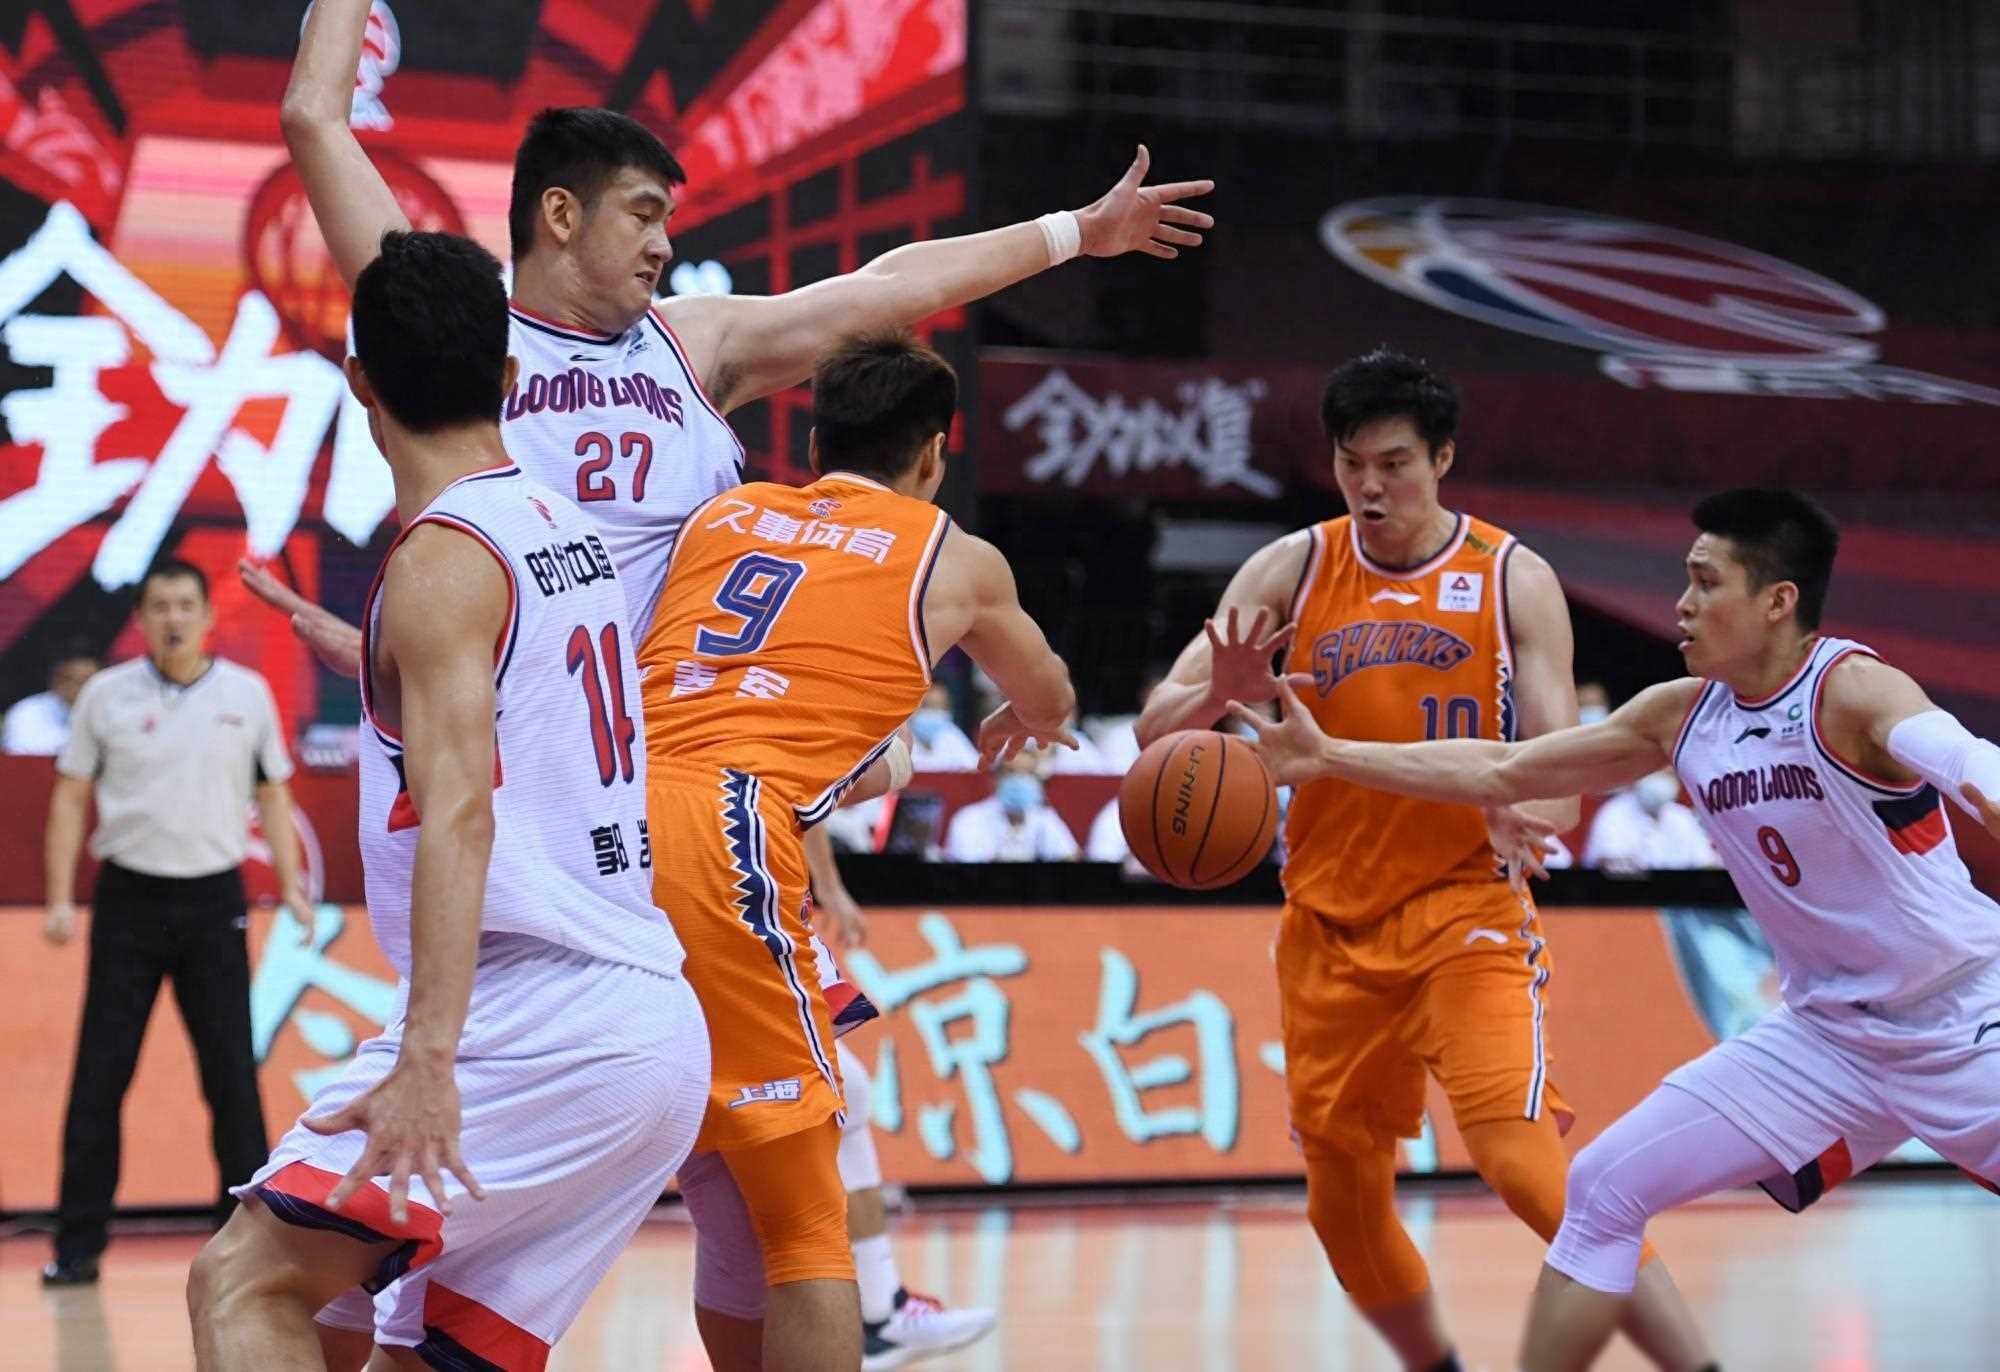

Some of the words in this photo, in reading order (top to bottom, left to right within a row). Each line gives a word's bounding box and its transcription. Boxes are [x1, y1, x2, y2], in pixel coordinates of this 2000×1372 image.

[607, 372, 684, 431] LIONS
[574, 431, 653, 503] 27
[706, 499, 897, 564] 久事体育
[693, 550, 808, 656] 9
[1311, 620, 1474, 698] SHARKS
[1418, 694, 1481, 741] 10
[1171, 744, 1206, 837] LI-NING
[1760, 764, 1825, 801] LIONS
[1757, 825, 1800, 887] 9
[845, 912, 1285, 1184] 凉白
[728, 1078, 801, 1110] 上海
